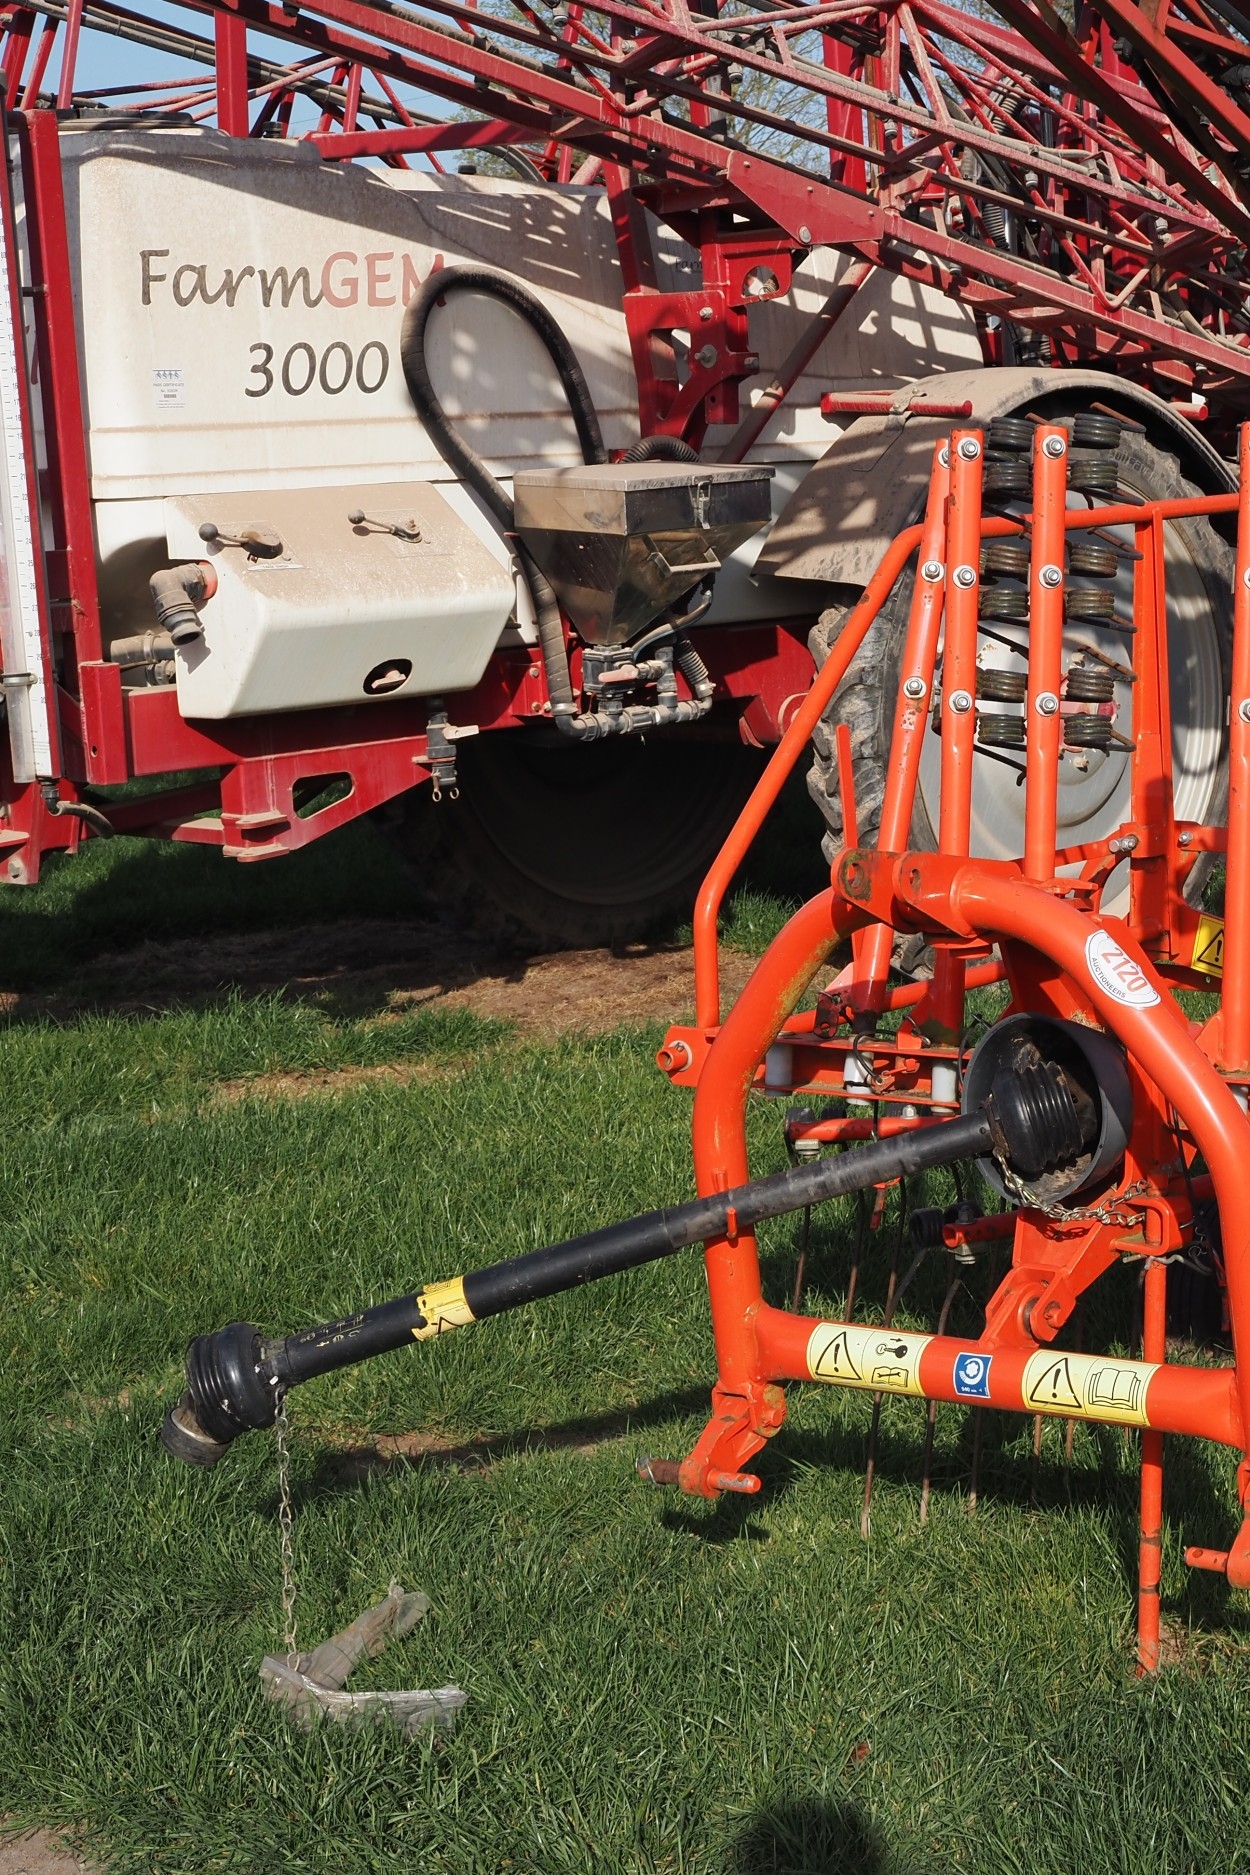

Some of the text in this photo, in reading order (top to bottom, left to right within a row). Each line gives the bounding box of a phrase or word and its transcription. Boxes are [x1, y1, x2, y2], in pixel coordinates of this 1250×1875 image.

[244, 340, 390, 398] 3000
[1092, 957, 1127, 999] AUCTIONEERS
[1101, 947, 1148, 992] 2120
